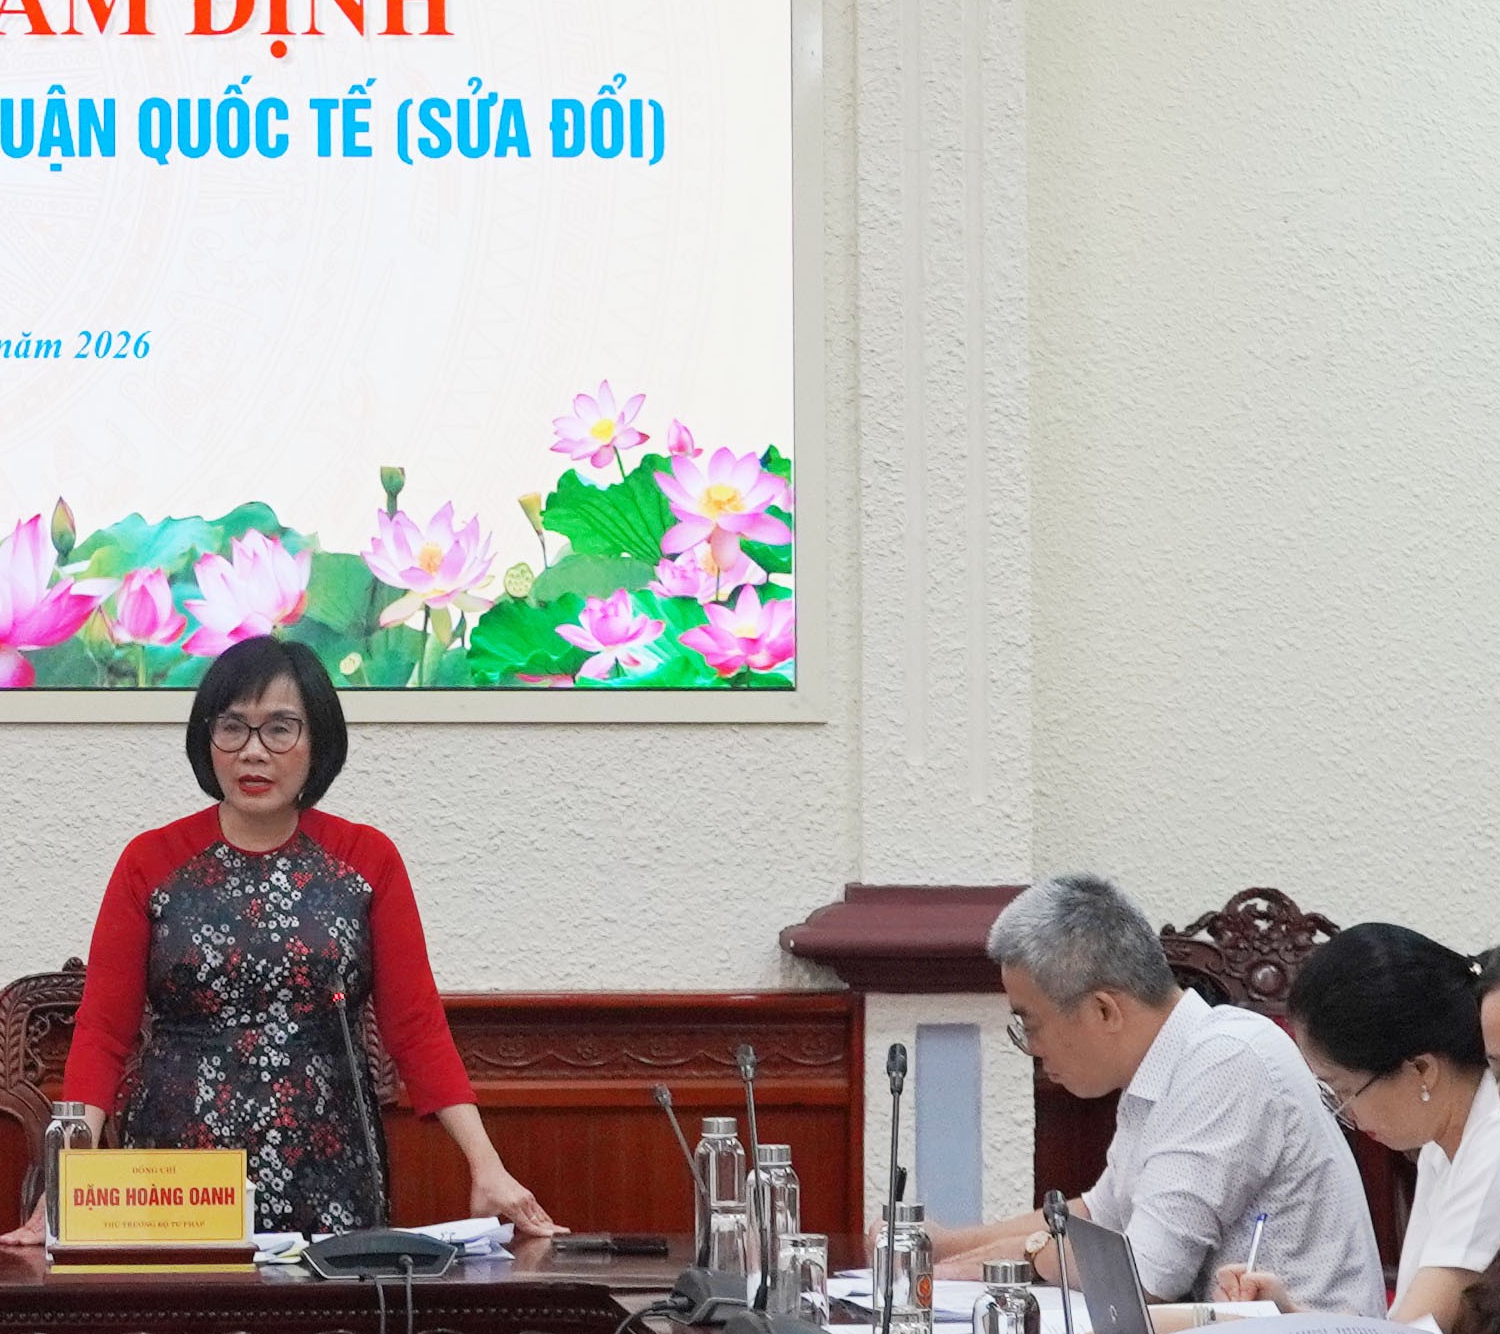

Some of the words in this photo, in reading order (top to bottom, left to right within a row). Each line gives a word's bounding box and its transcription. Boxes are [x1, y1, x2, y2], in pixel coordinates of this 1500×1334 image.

[137, 74, 290, 167] QUỐC
[308, 77, 377, 159] TẾ
[396, 75, 532, 166] (SỬA
[547, 72, 666, 167] ĐỔI)
[74, 330, 151, 360] 2026
[73, 1183, 120, 1211] ĐẶNG
[126, 1183, 184, 1207] HOÀNG
[189, 1186, 236, 1206] OANH
